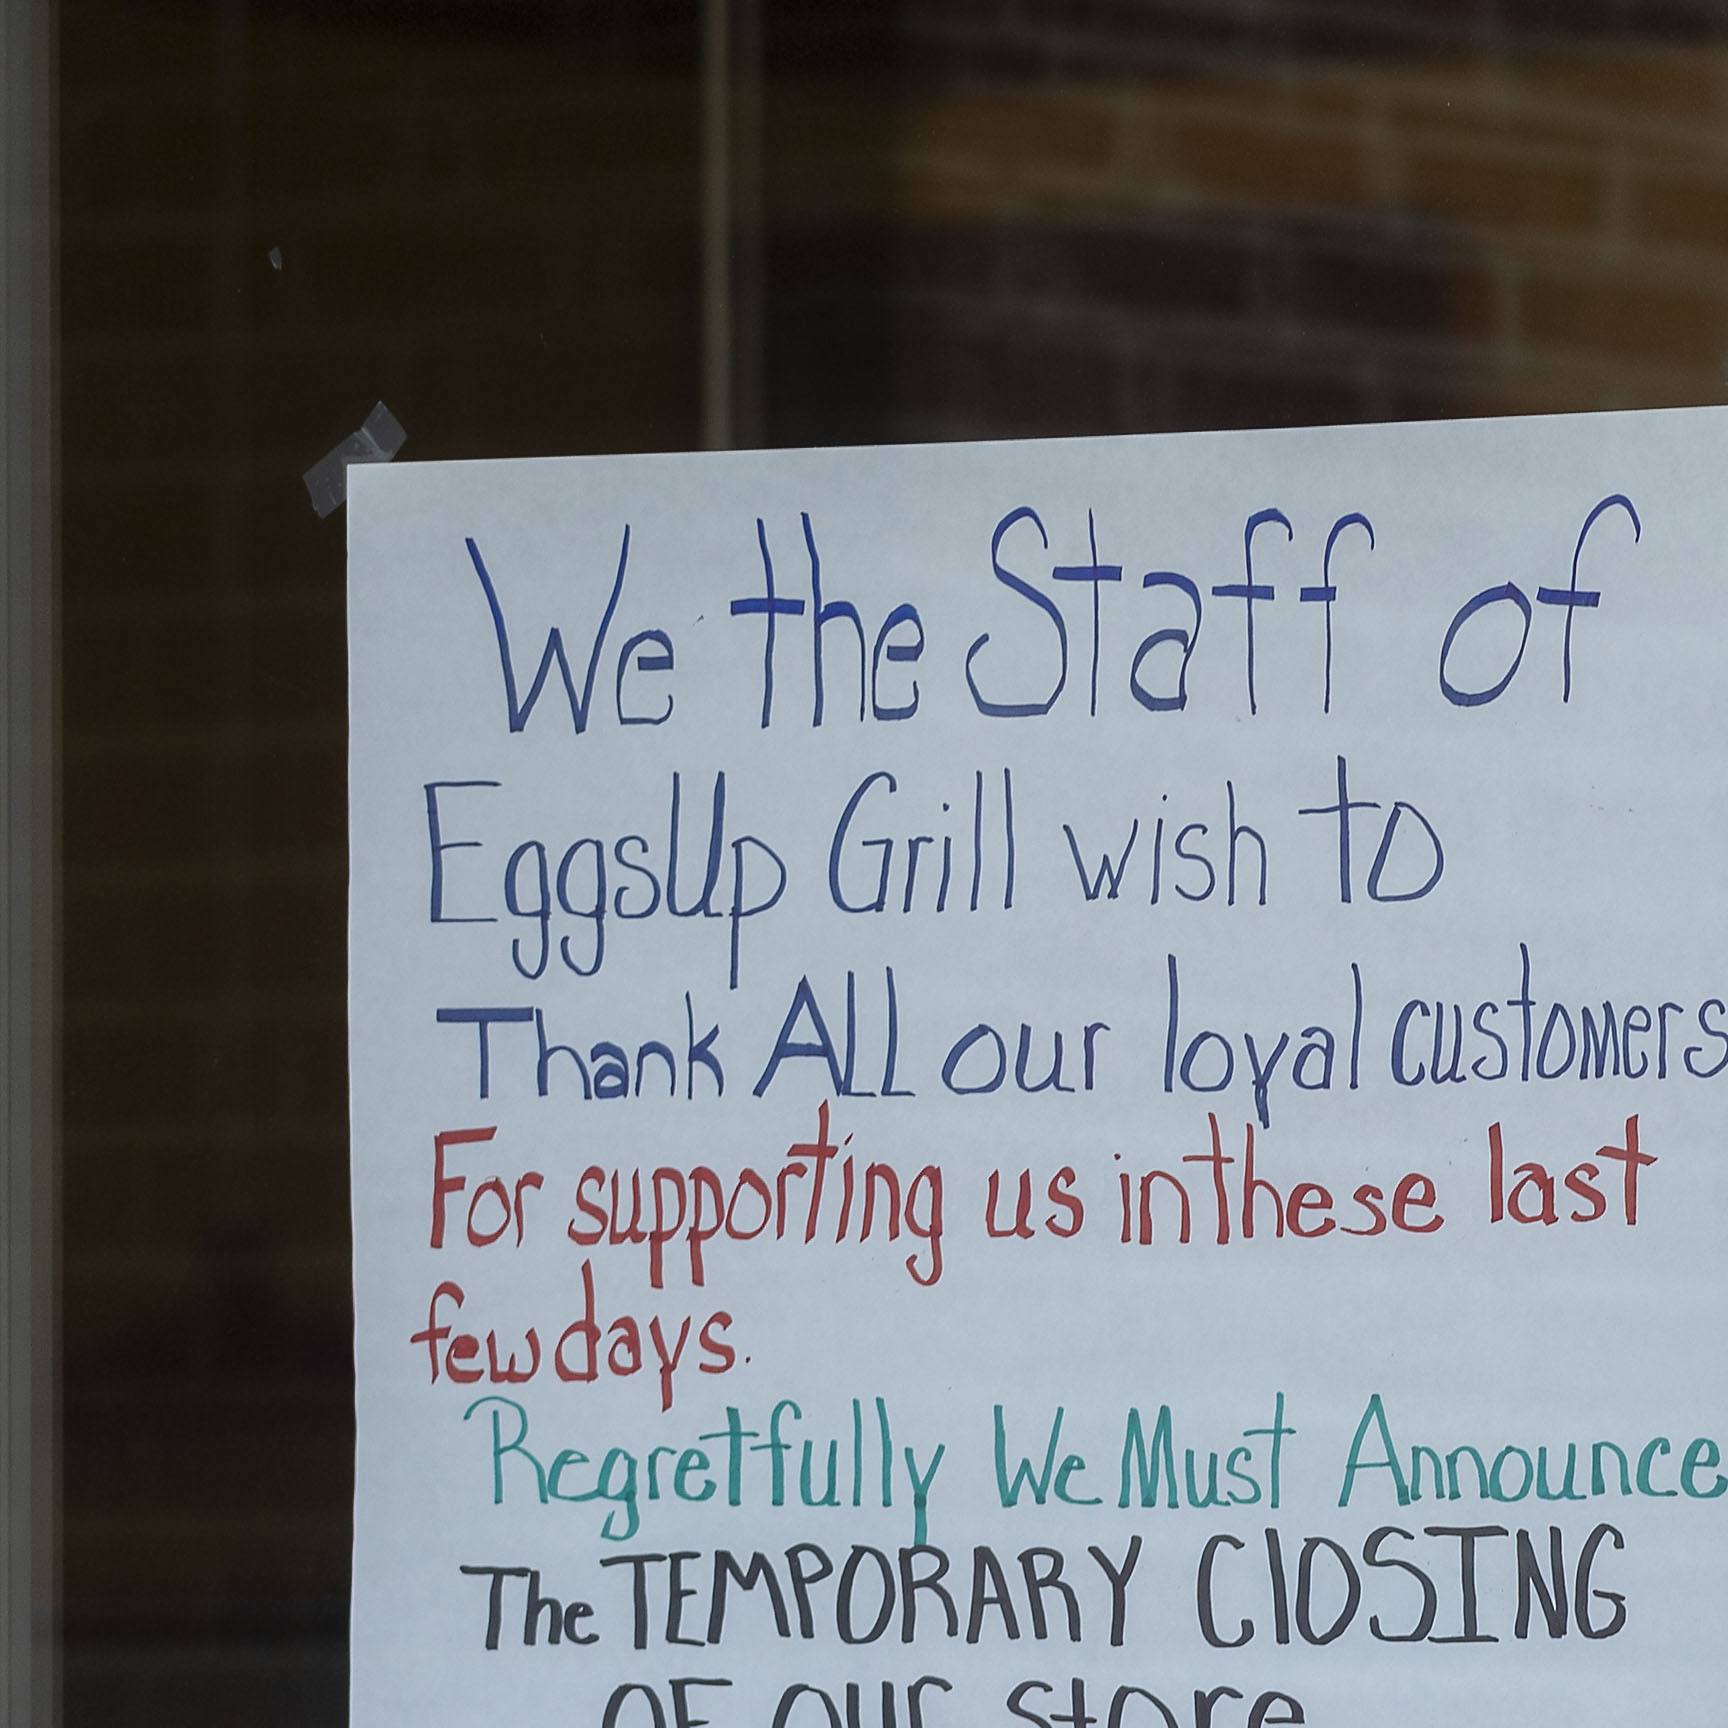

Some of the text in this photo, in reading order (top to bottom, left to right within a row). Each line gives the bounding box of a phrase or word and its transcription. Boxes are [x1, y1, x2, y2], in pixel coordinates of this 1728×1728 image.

[465, 494, 1640, 735] We the Staff of
[829, 768, 1014, 913] Grill
[1063, 780, 1266, 906] wish
[1299, 755, 1444, 903] to
[436, 991, 724, 1100] Thank
[942, 1023, 1110, 1095] our
[1164, 954, 1362, 1129] loyal
[430, 1126, 544, 1249] For
[568, 1099, 943, 1289] supporting
[985, 1166, 1084, 1239] us
[1489, 1114, 1658, 1226] last
[464, 1392, 1728, 1546] Regretfully We Must Announce
[459, 1565, 600, 1651] The
[600, 1535, 1142, 1650] TEMPORARY
